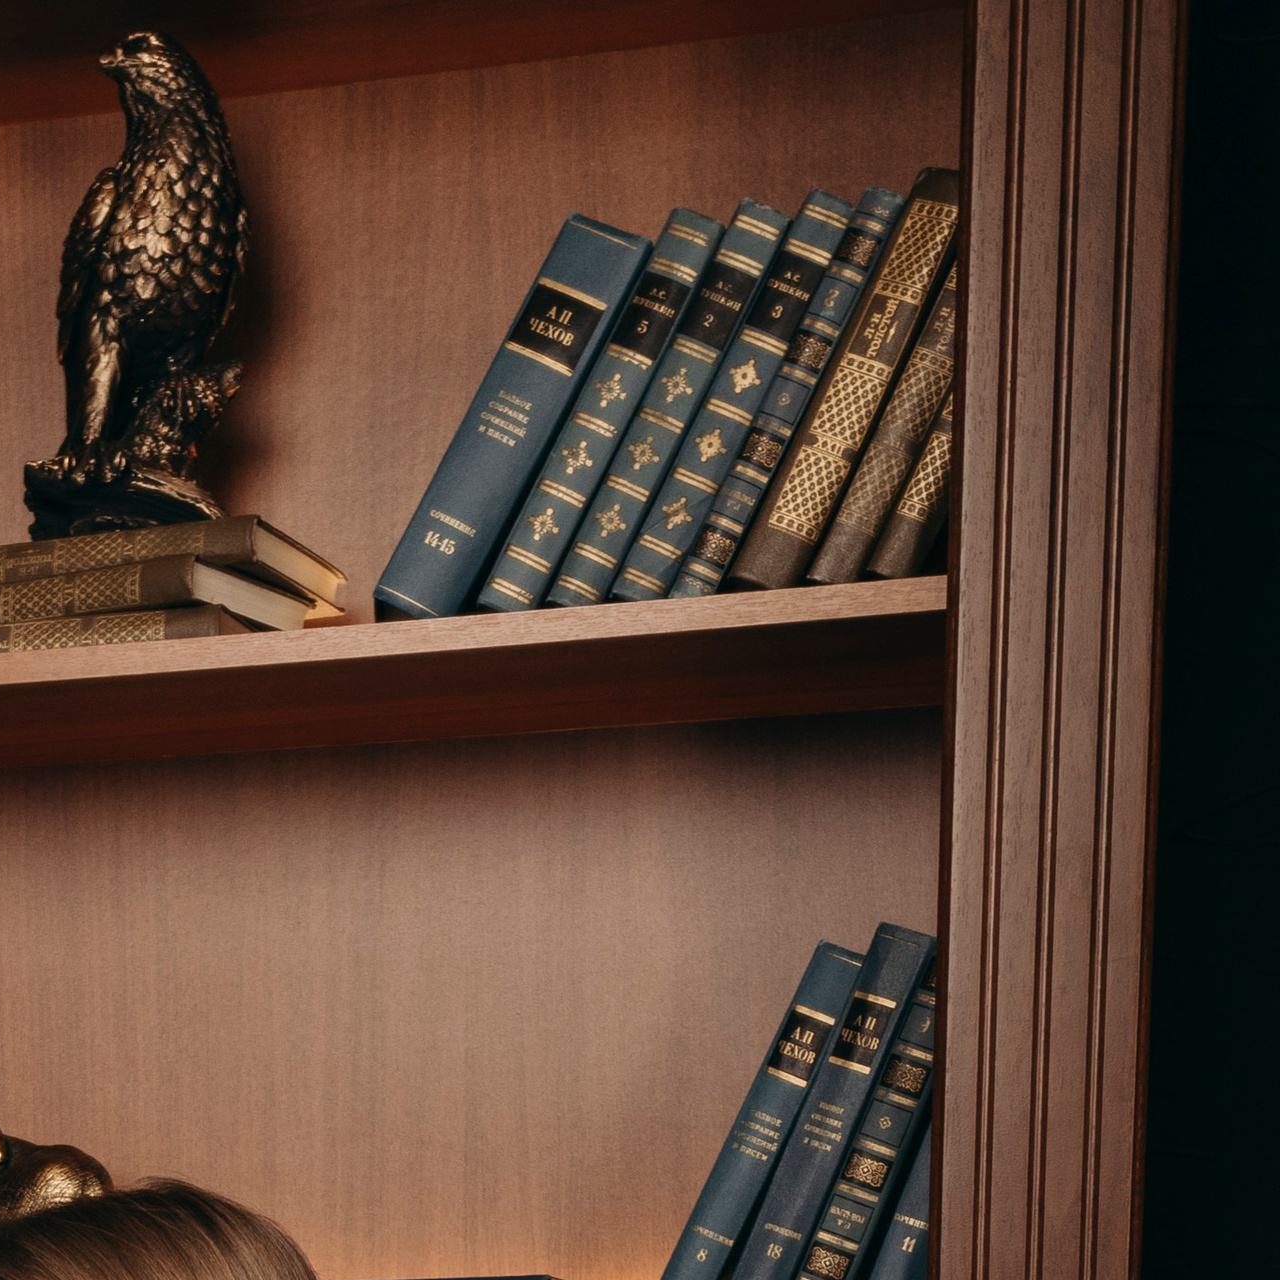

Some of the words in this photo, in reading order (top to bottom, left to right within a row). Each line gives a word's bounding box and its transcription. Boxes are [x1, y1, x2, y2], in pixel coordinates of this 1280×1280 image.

[703, 313, 715, 328] 2
[772, 305, 784, 319] 3
[529, 316, 575, 347] ЧЕХОВ
[637, 320, 650, 335] 5
[866, 298, 900, 358] ТОЛСТОЙ
[424, 530, 457, 556] 14-15
[841, 1027, 880, 1051] ЧЕХОВ
[778, 1040, 816, 1065] ЧЕХОВ
[767, 1243, 784, 1260] 18
[900, 1235, 917, 1253] 11
[696, 1247, 709, 1262] 8
